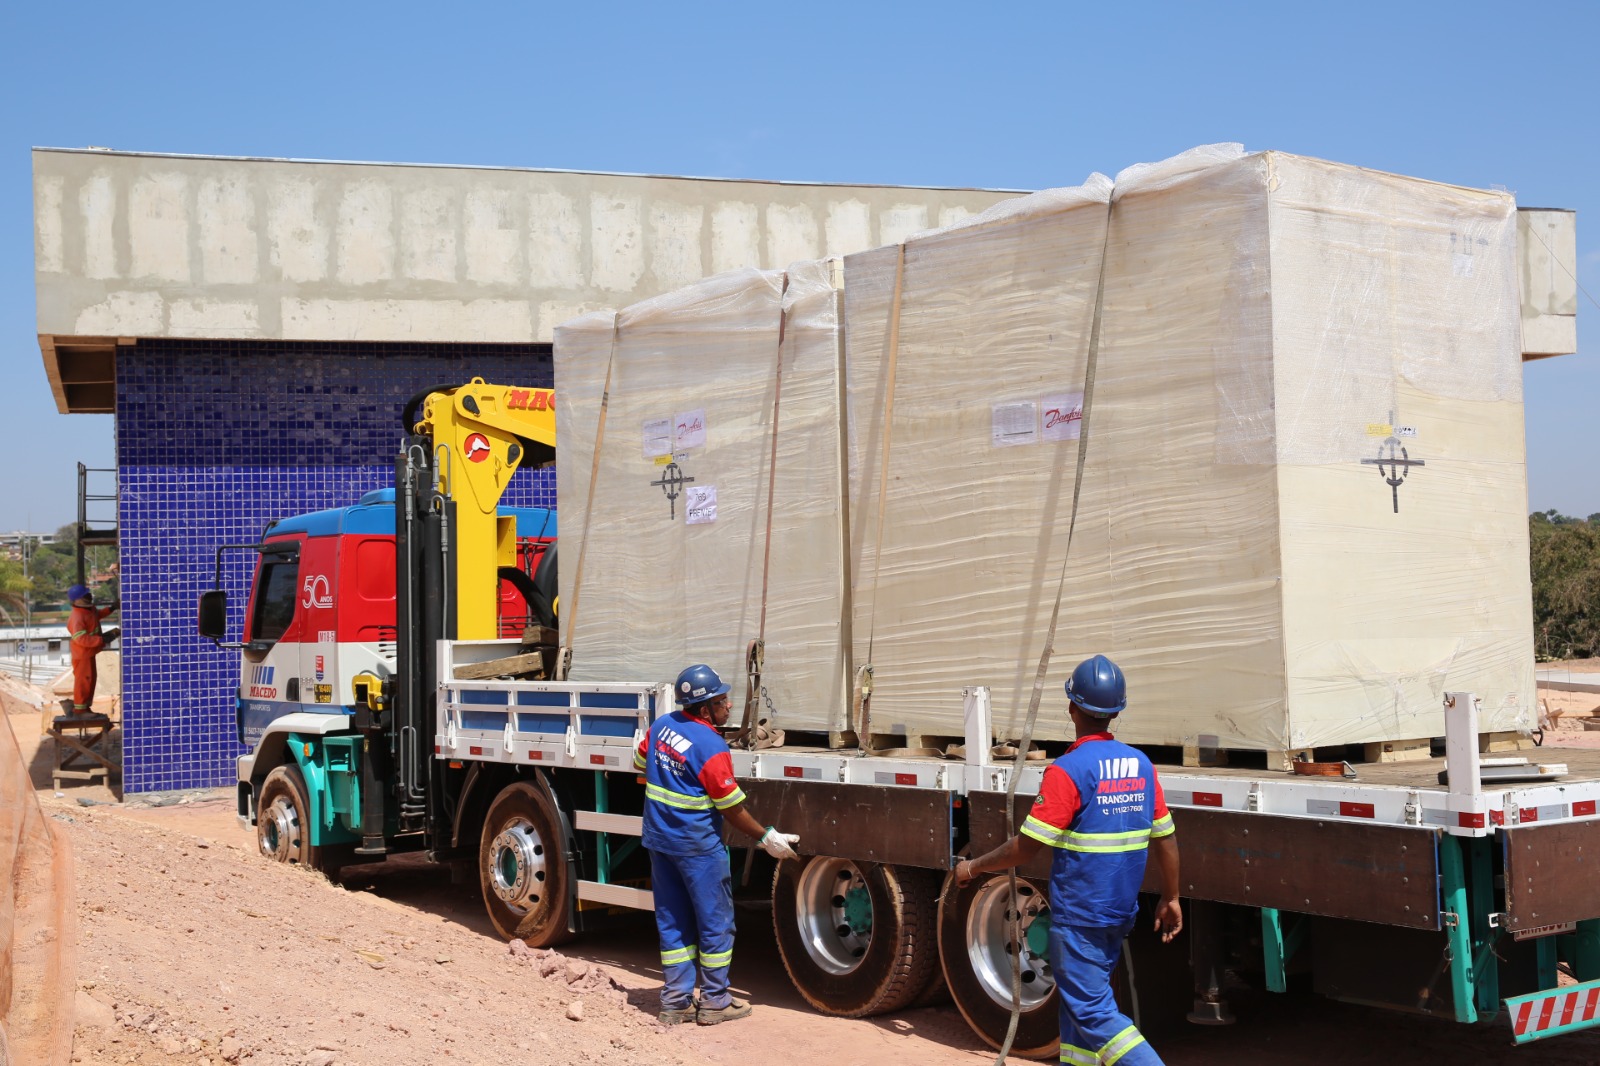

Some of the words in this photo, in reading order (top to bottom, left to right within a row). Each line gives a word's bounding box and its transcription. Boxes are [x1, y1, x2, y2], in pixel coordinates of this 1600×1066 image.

[303, 575, 333, 608] 50
[249, 686, 277, 698] MACEDO
[1097, 778, 1145, 794] MACEDO
